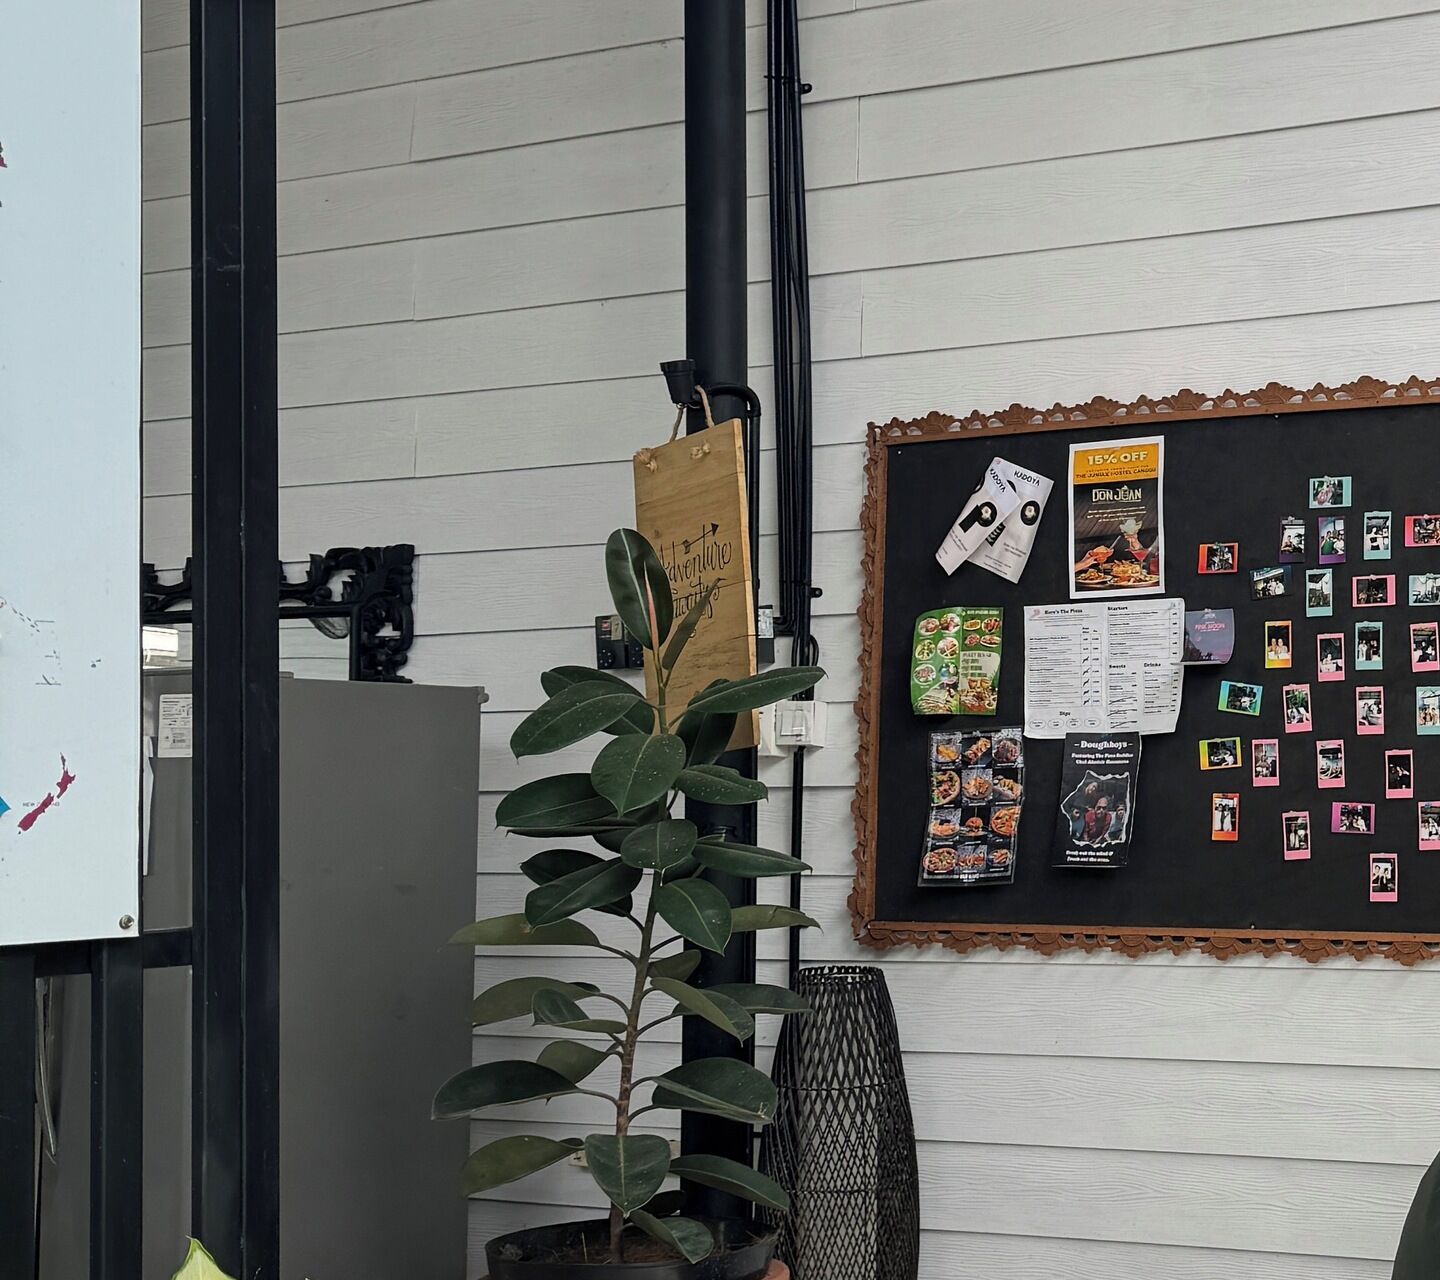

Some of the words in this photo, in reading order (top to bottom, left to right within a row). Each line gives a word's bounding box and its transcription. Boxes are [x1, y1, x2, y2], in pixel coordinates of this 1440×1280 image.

[1088, 453, 1118, 465] 15%
[1119, 451, 1148, 462] OFF
[1092, 489, 1113, 502] DON
[1080, 740, 1128, 751] Doughboys
